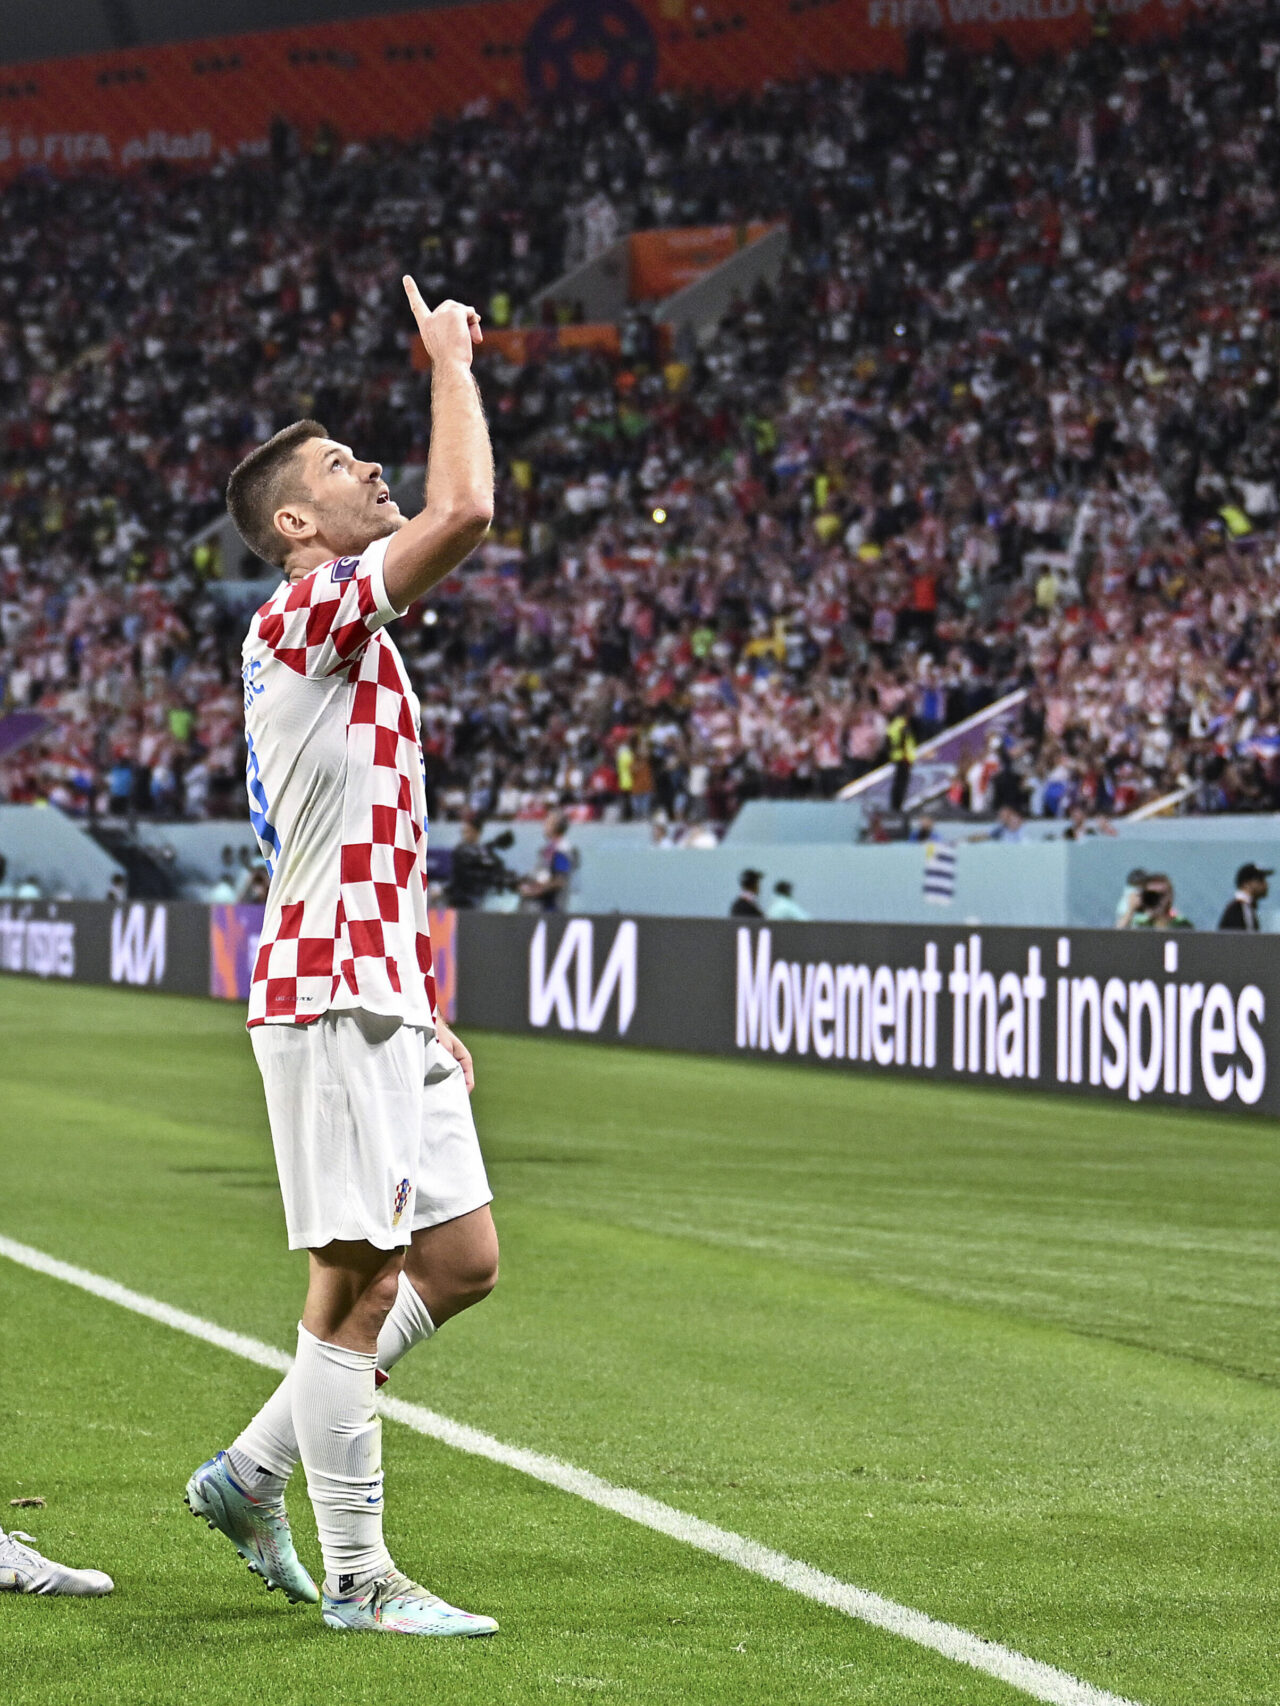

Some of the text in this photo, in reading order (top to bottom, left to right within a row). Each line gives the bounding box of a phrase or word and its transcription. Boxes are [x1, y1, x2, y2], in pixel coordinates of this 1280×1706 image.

[735, 925, 1266, 1105] Movement that inspires
